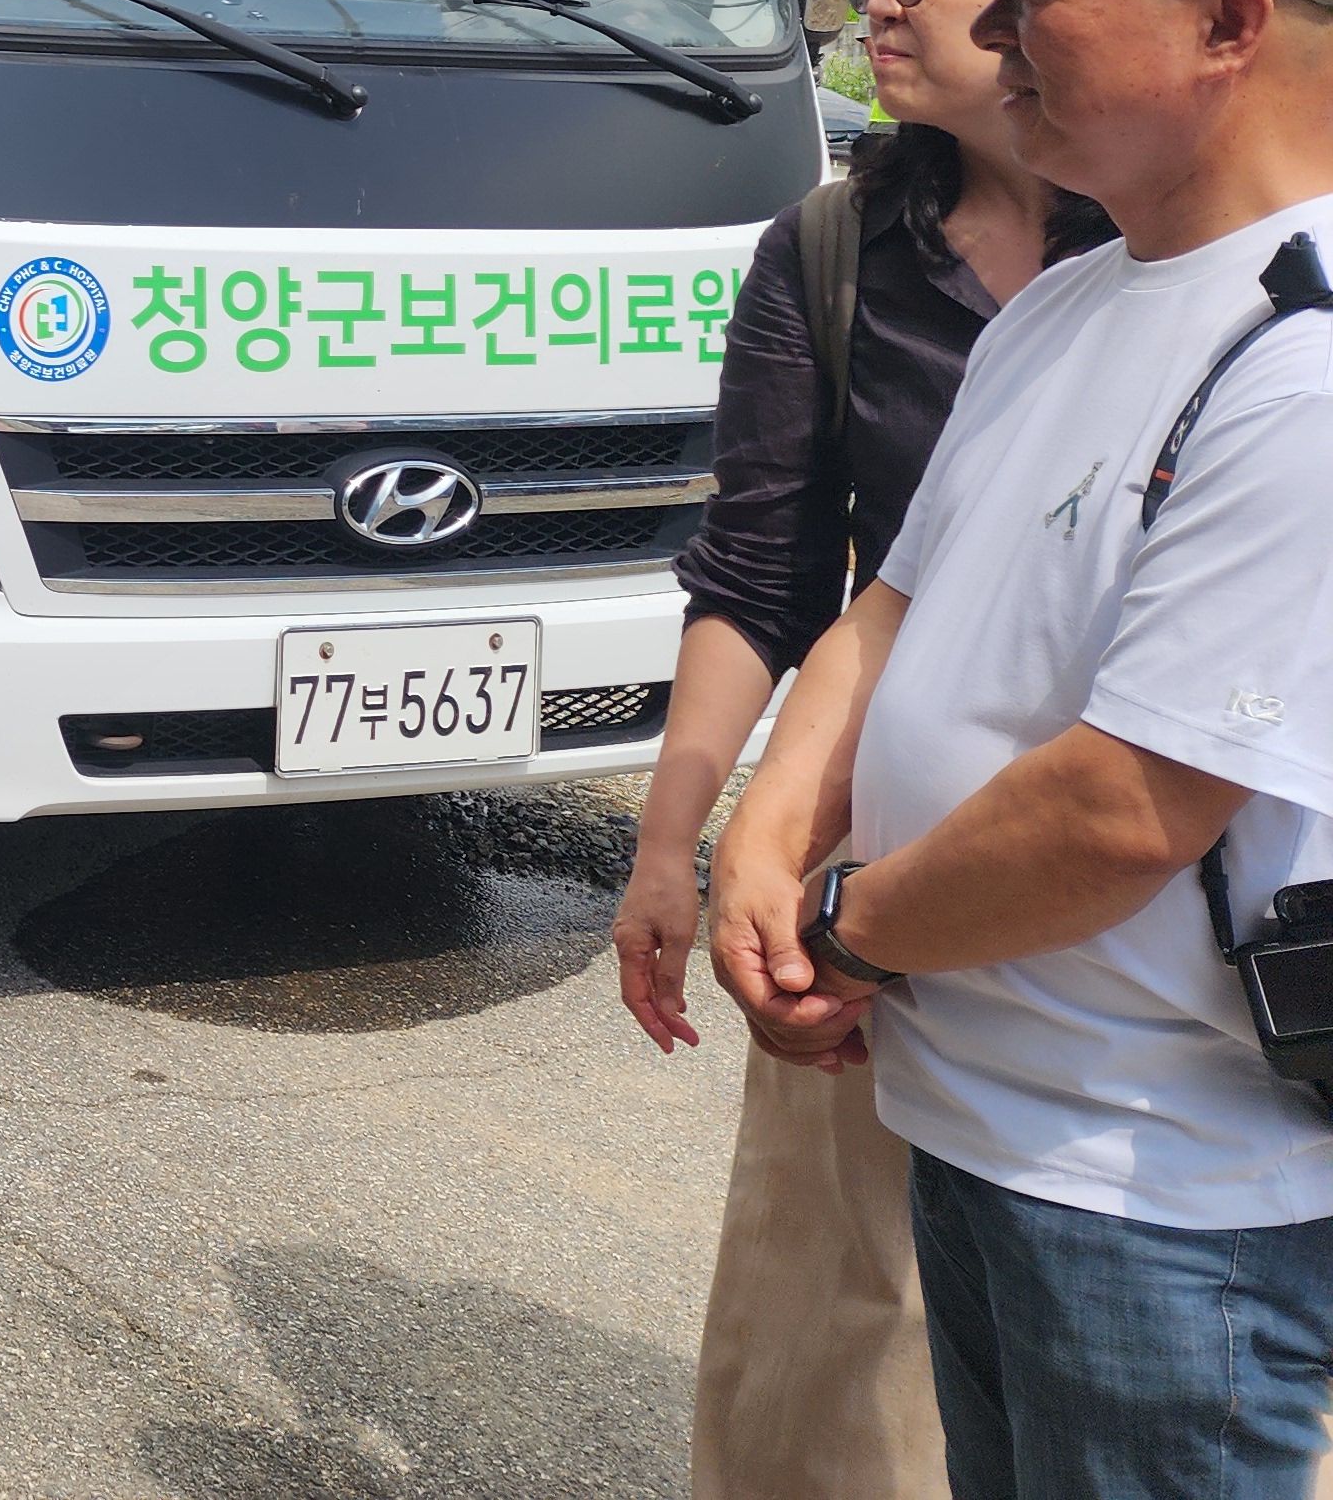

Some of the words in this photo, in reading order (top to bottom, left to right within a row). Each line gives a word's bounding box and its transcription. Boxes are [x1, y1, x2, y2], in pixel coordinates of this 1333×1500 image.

[14, 264, 38, 285] PHC
[40, 260, 50, 271] &
[69, 264, 107, 315] HOSPITAL
[130, 264, 741, 374] 청양군보건의료원
[9, 348, 98, 380] 청양군보건의료원
[288, 663, 529, 745] 77부5637
[1223, 687, 1285, 728] K2
